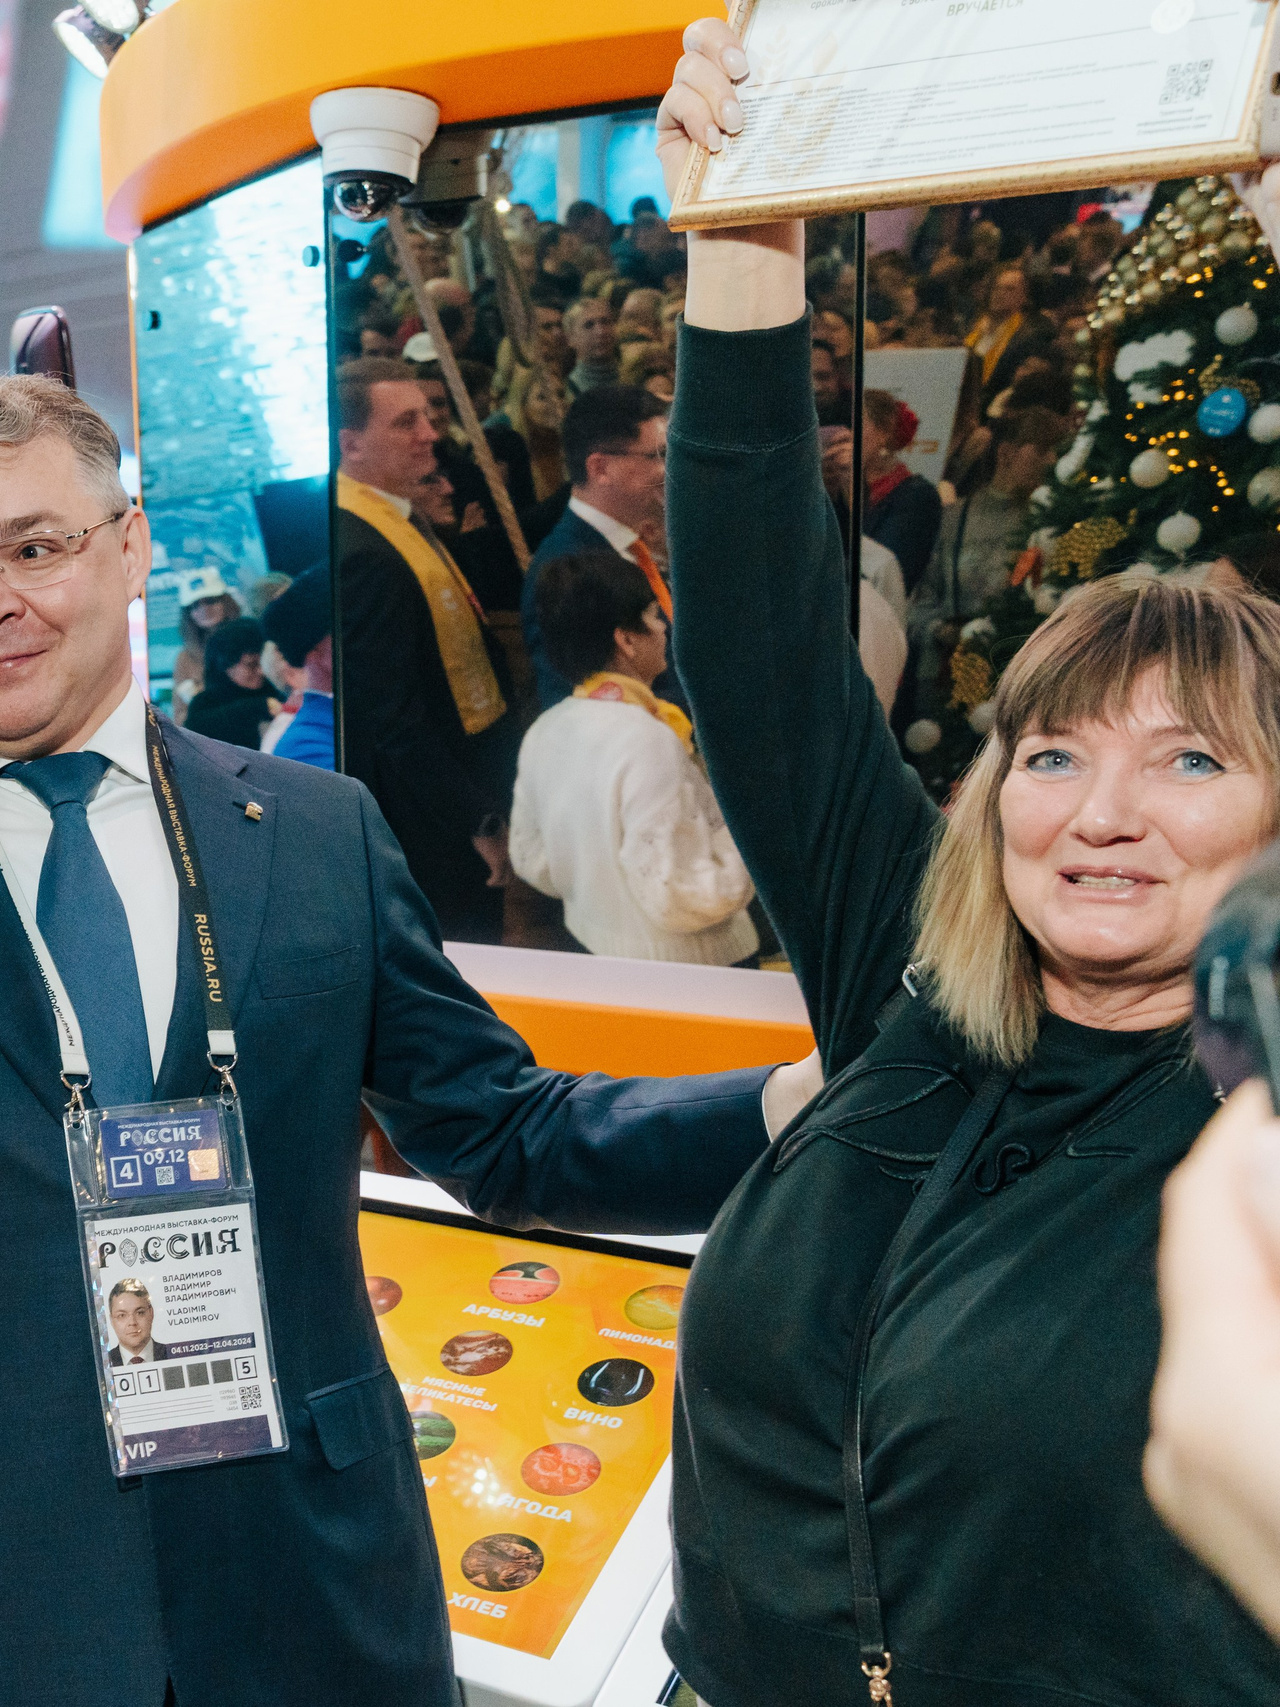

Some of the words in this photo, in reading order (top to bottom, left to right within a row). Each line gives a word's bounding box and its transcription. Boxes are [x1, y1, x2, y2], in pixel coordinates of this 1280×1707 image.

[169, 809, 197, 887] ВЫСТАВКА-ФОРУМ
[194, 913, 223, 1003] RUSSIA.RU
[119, 1125, 202, 1147] РОССИЯ
[143, 1149, 185, 1166] 09.12
[120, 1162, 134, 1179] 4
[94, 1222, 166, 1237] МЕЖДУНАРОДНАЯ
[167, 1214, 239, 1229] ВЫСТАВКА-ФОРУМ
[98, 1228, 242, 1269] РОССИЯ
[162, 1269, 222, 1283] ВЛАДИМИРОВ
[163, 1281, 212, 1293] ВЛАДИМИР
[165, 1288, 237, 1303] ВЛАДИМИРОВИЧ
[167, 1305, 206, 1316] VLADIMIR
[168, 1314, 220, 1326] VLADIMIROV
[461, 1303, 546, 1328] АРБУЗЫ
[598, 1328, 677, 1349] ЛИМОНАД
[120, 1378, 130, 1391] 0
[145, 1375, 152, 1388] 1
[241, 1361, 251, 1374] 5
[422, 1376, 487, 1396] МЯСНЫЕ
[563, 1407, 624, 1428] ВИНО
[125, 1441, 158, 1460] VIP
[497, 1493, 572, 1522] ЯГОДА
[447, 1592, 508, 1618] ХЛЕБ
